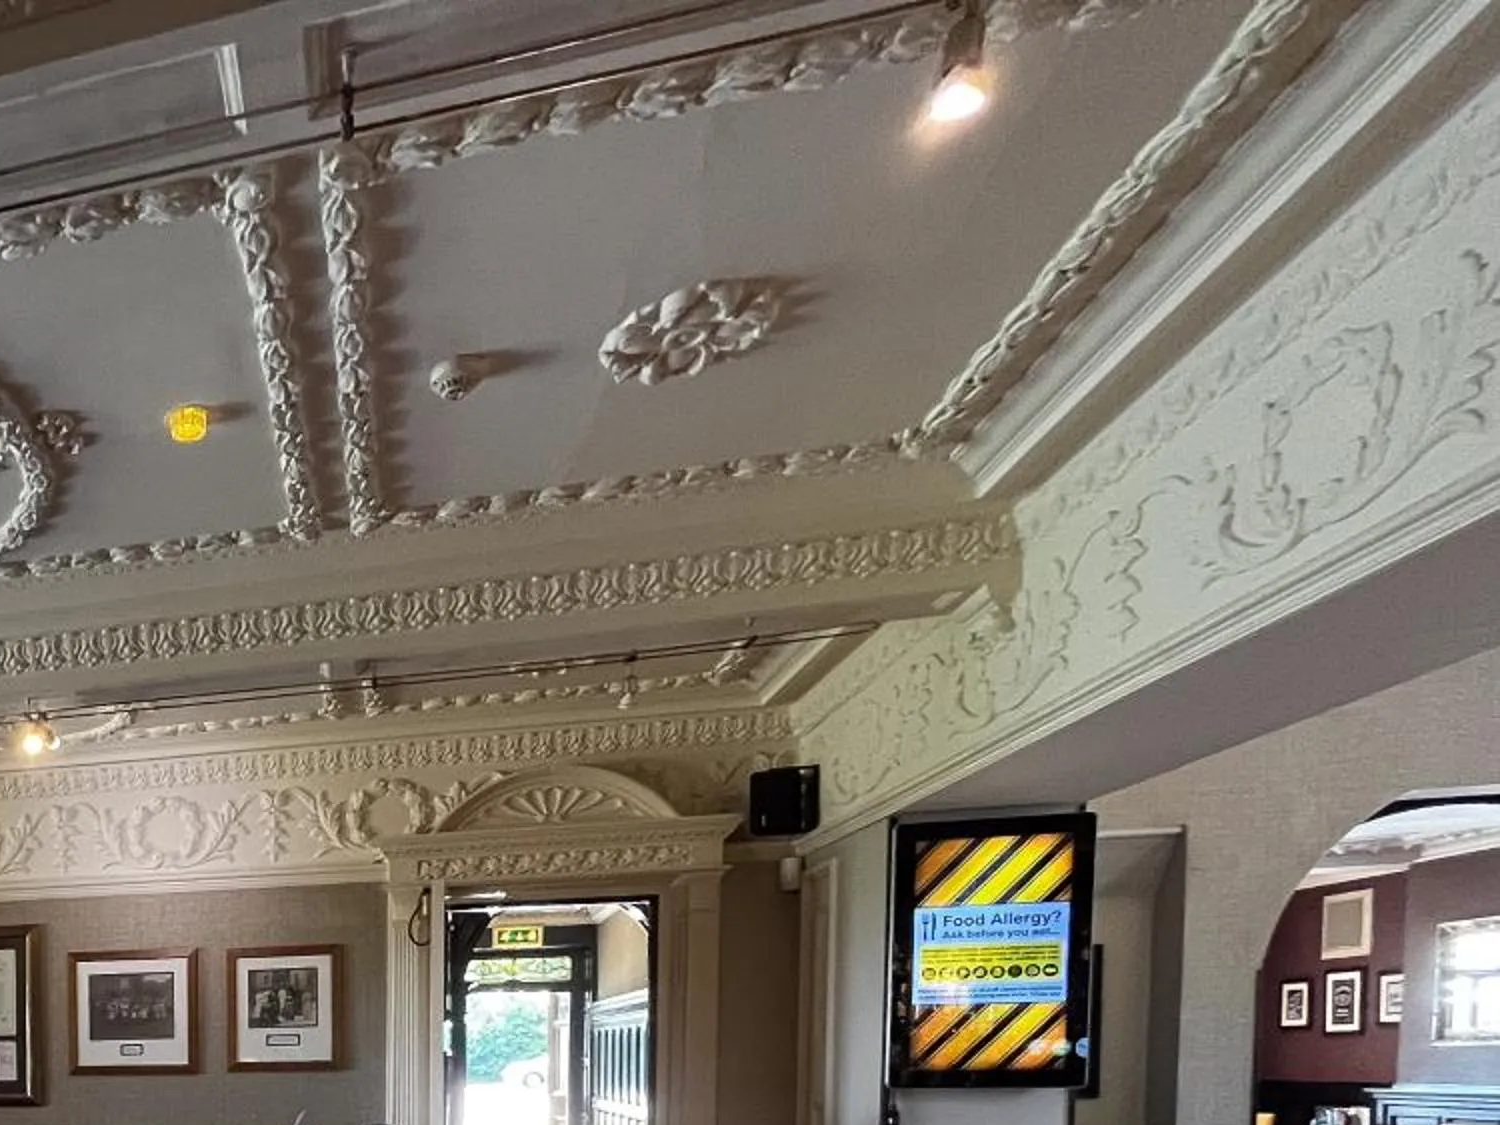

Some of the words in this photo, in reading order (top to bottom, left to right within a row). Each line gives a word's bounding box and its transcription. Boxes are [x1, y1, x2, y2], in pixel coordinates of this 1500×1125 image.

[943, 914, 985, 927] Food
[991, 910, 1062, 926] Allergy?
[942, 931, 964, 939] Ask
[967, 929, 1006, 938] before
[1007, 929, 1029, 938] you
